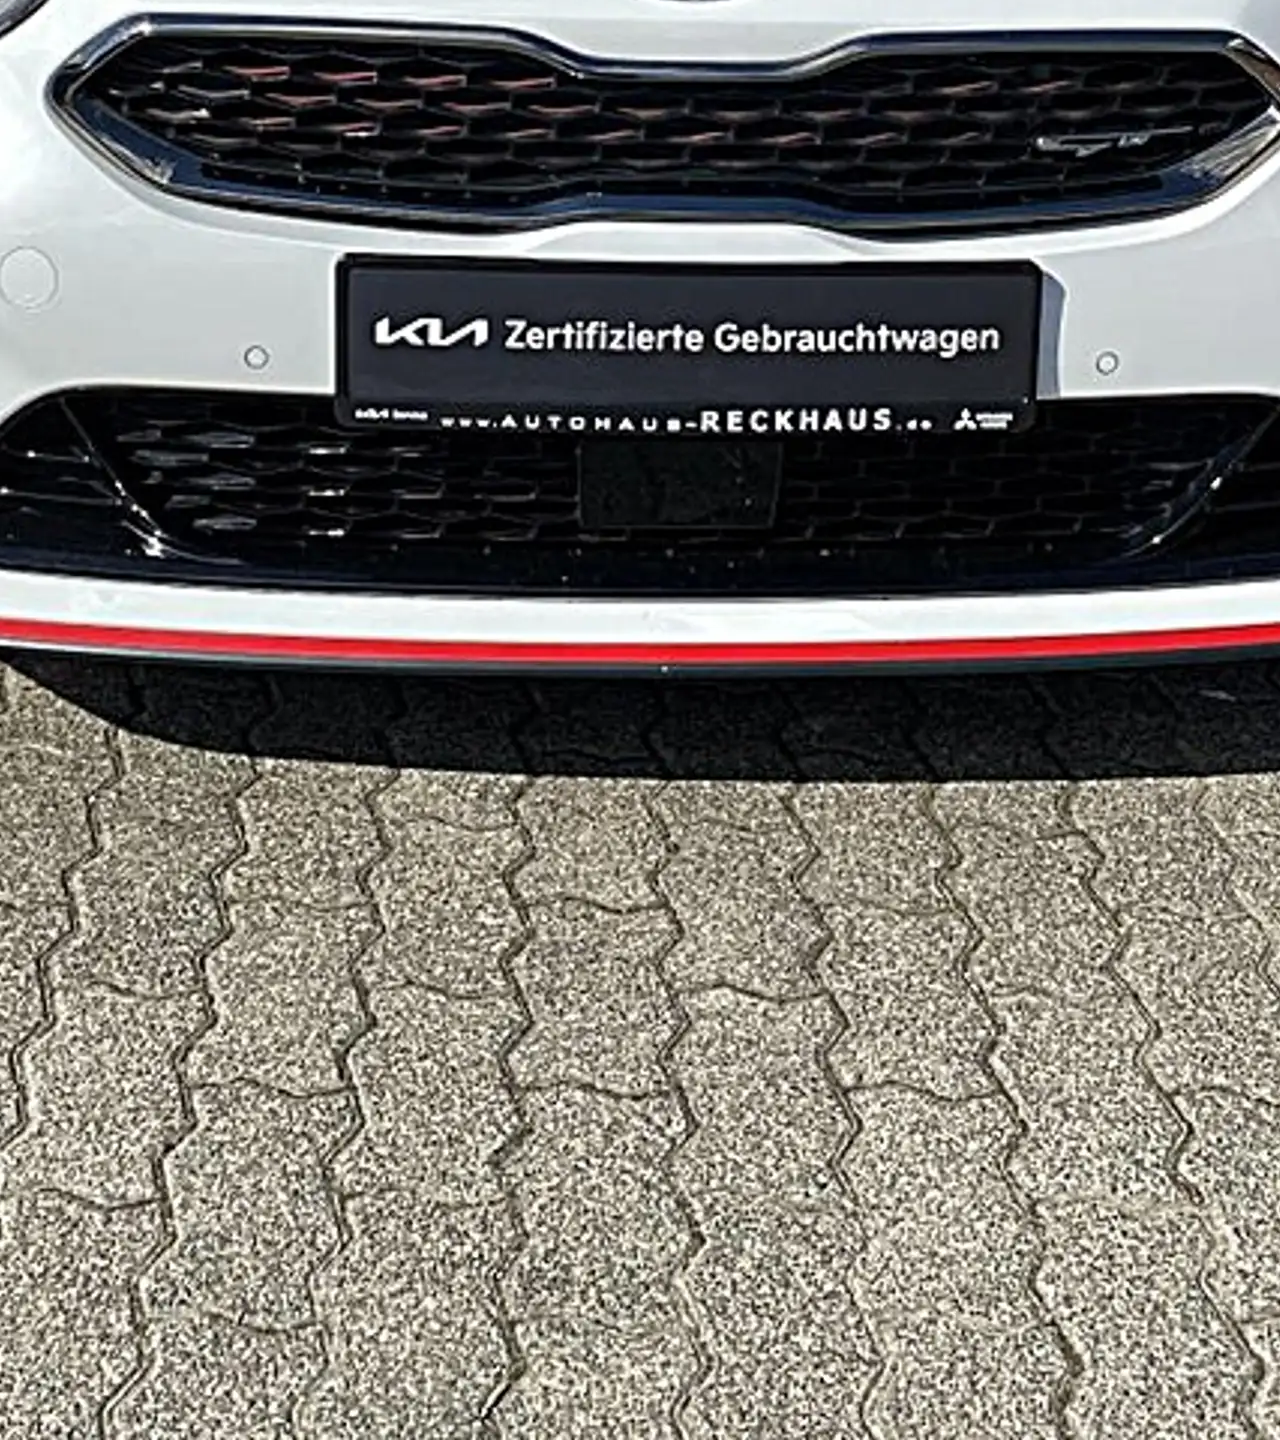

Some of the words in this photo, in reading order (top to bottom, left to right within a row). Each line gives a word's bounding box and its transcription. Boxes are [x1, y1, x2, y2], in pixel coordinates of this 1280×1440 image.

[375, 317, 489, 347] KIA
[504, 320, 704, 351] Zertifizierte
[714, 322, 1001, 359] Gebrauchtwagen
